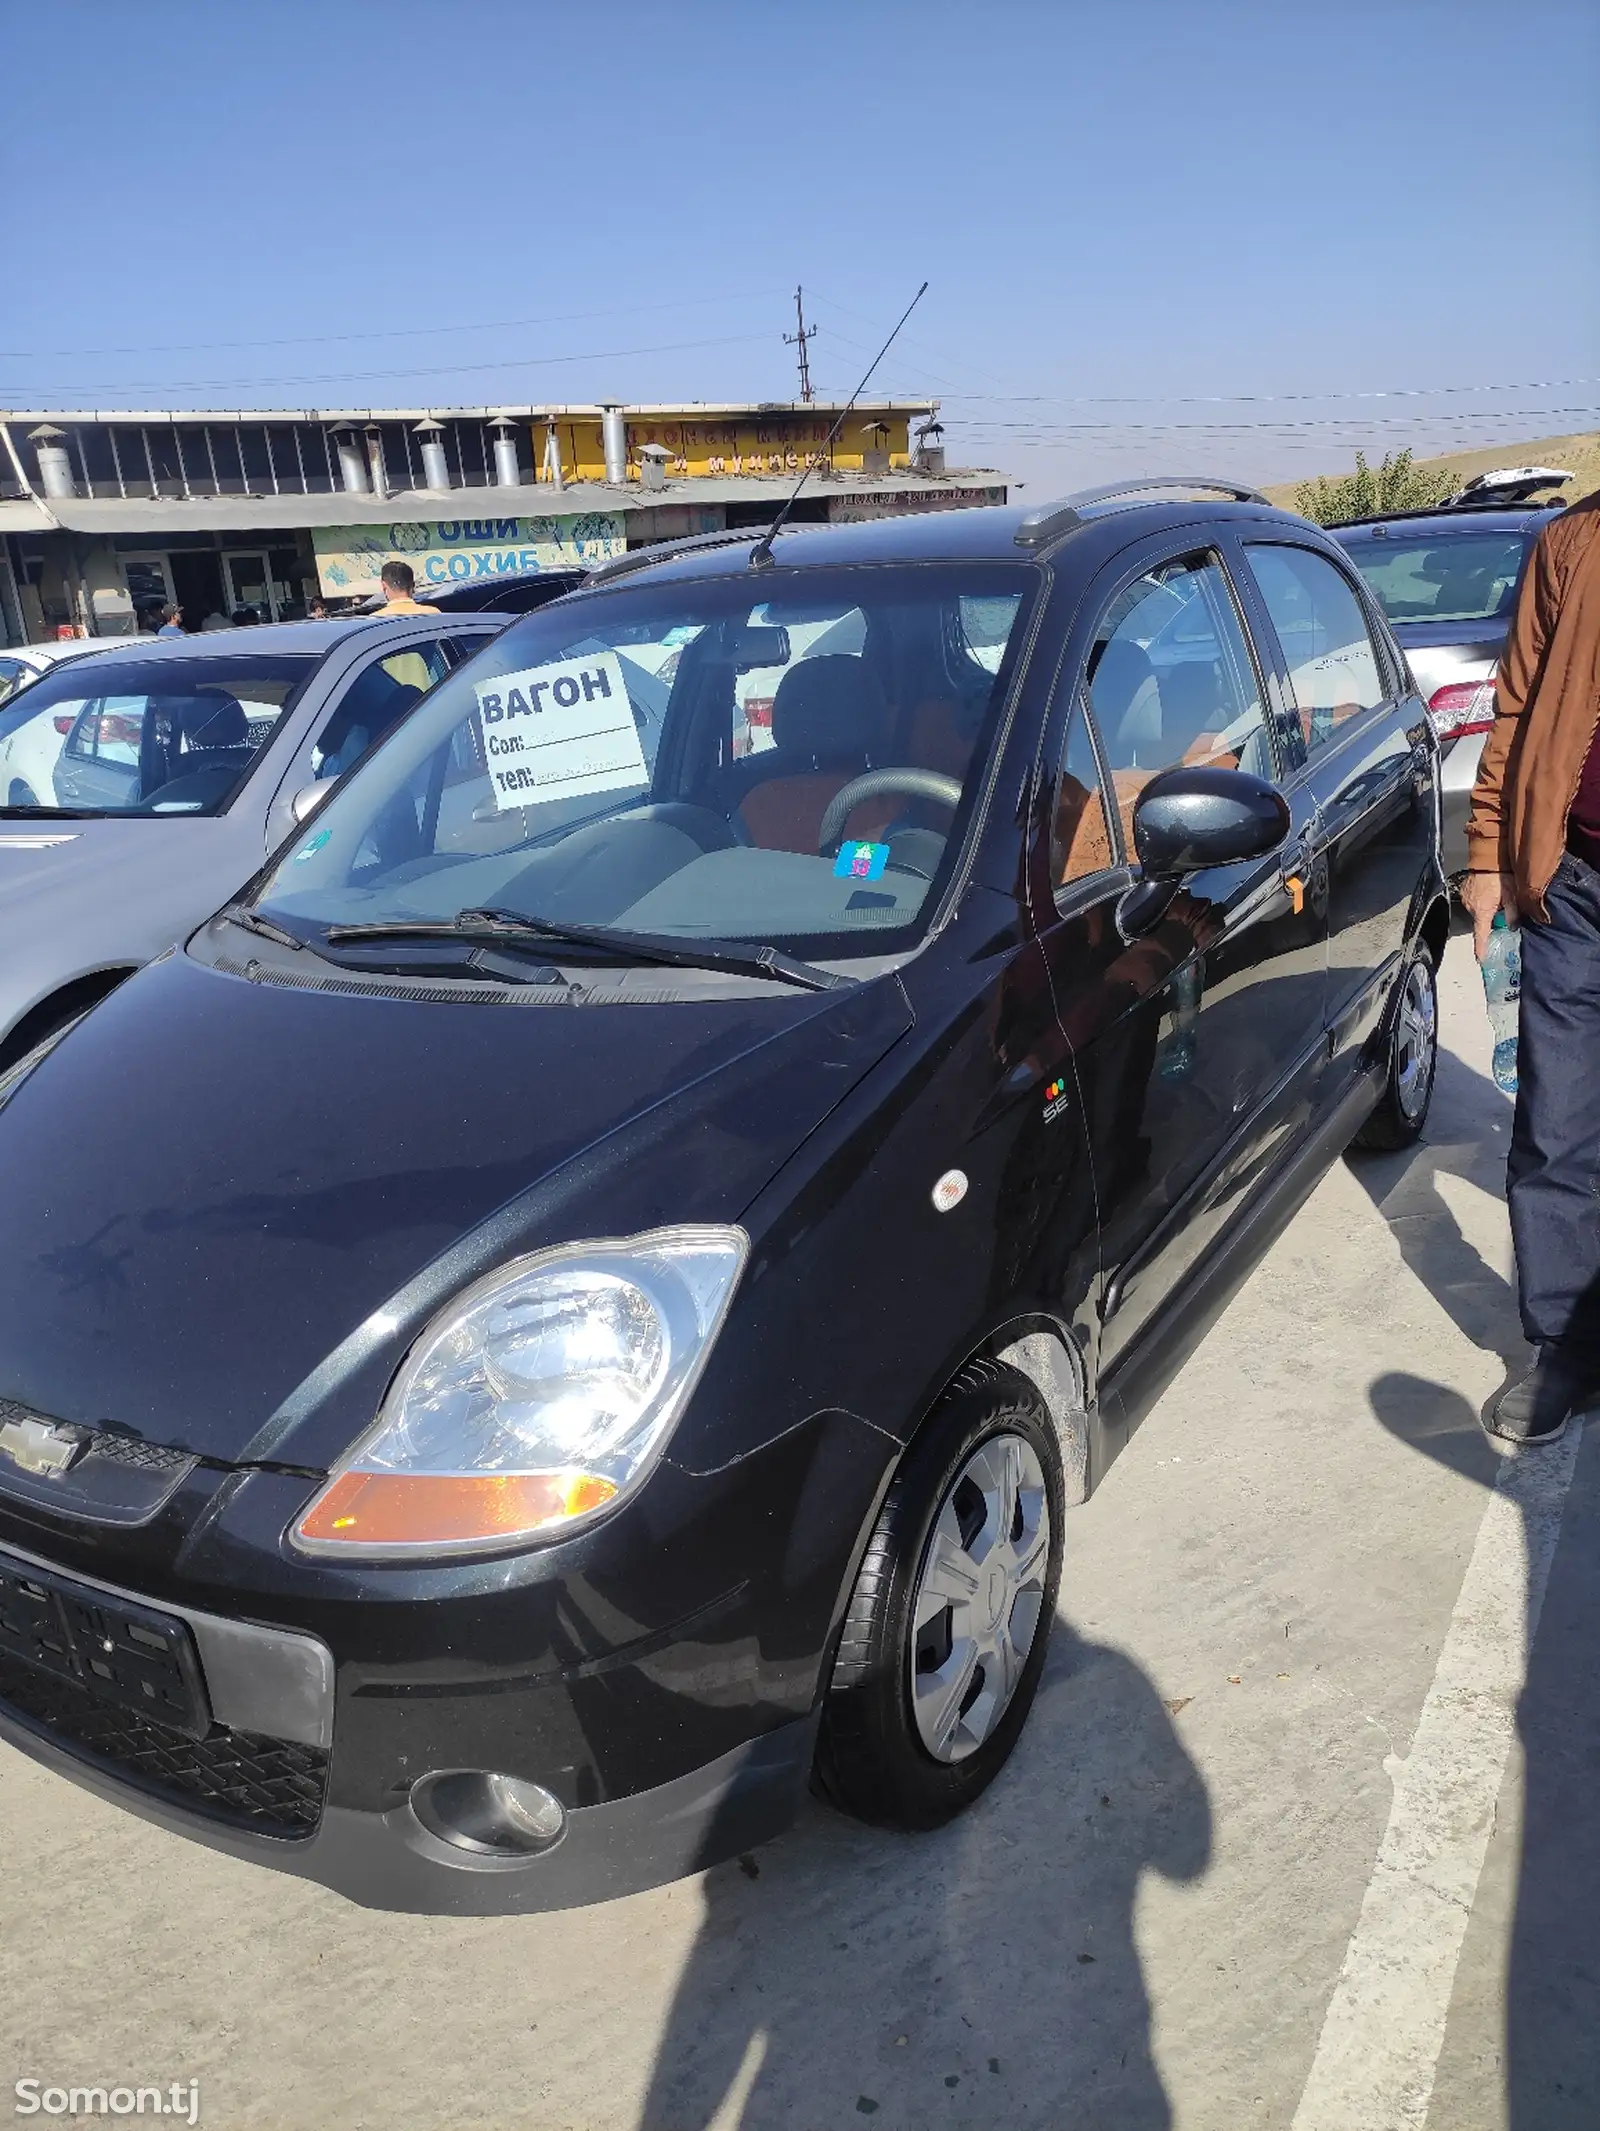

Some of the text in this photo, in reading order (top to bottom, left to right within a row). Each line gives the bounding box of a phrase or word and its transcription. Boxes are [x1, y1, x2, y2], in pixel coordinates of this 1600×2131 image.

[437, 518, 519, 542] ОШИ
[425, 550, 540, 582] СОХИБ
[482, 667, 612, 724] ВАГОН
[1042, 1092, 1069, 1124] SE
